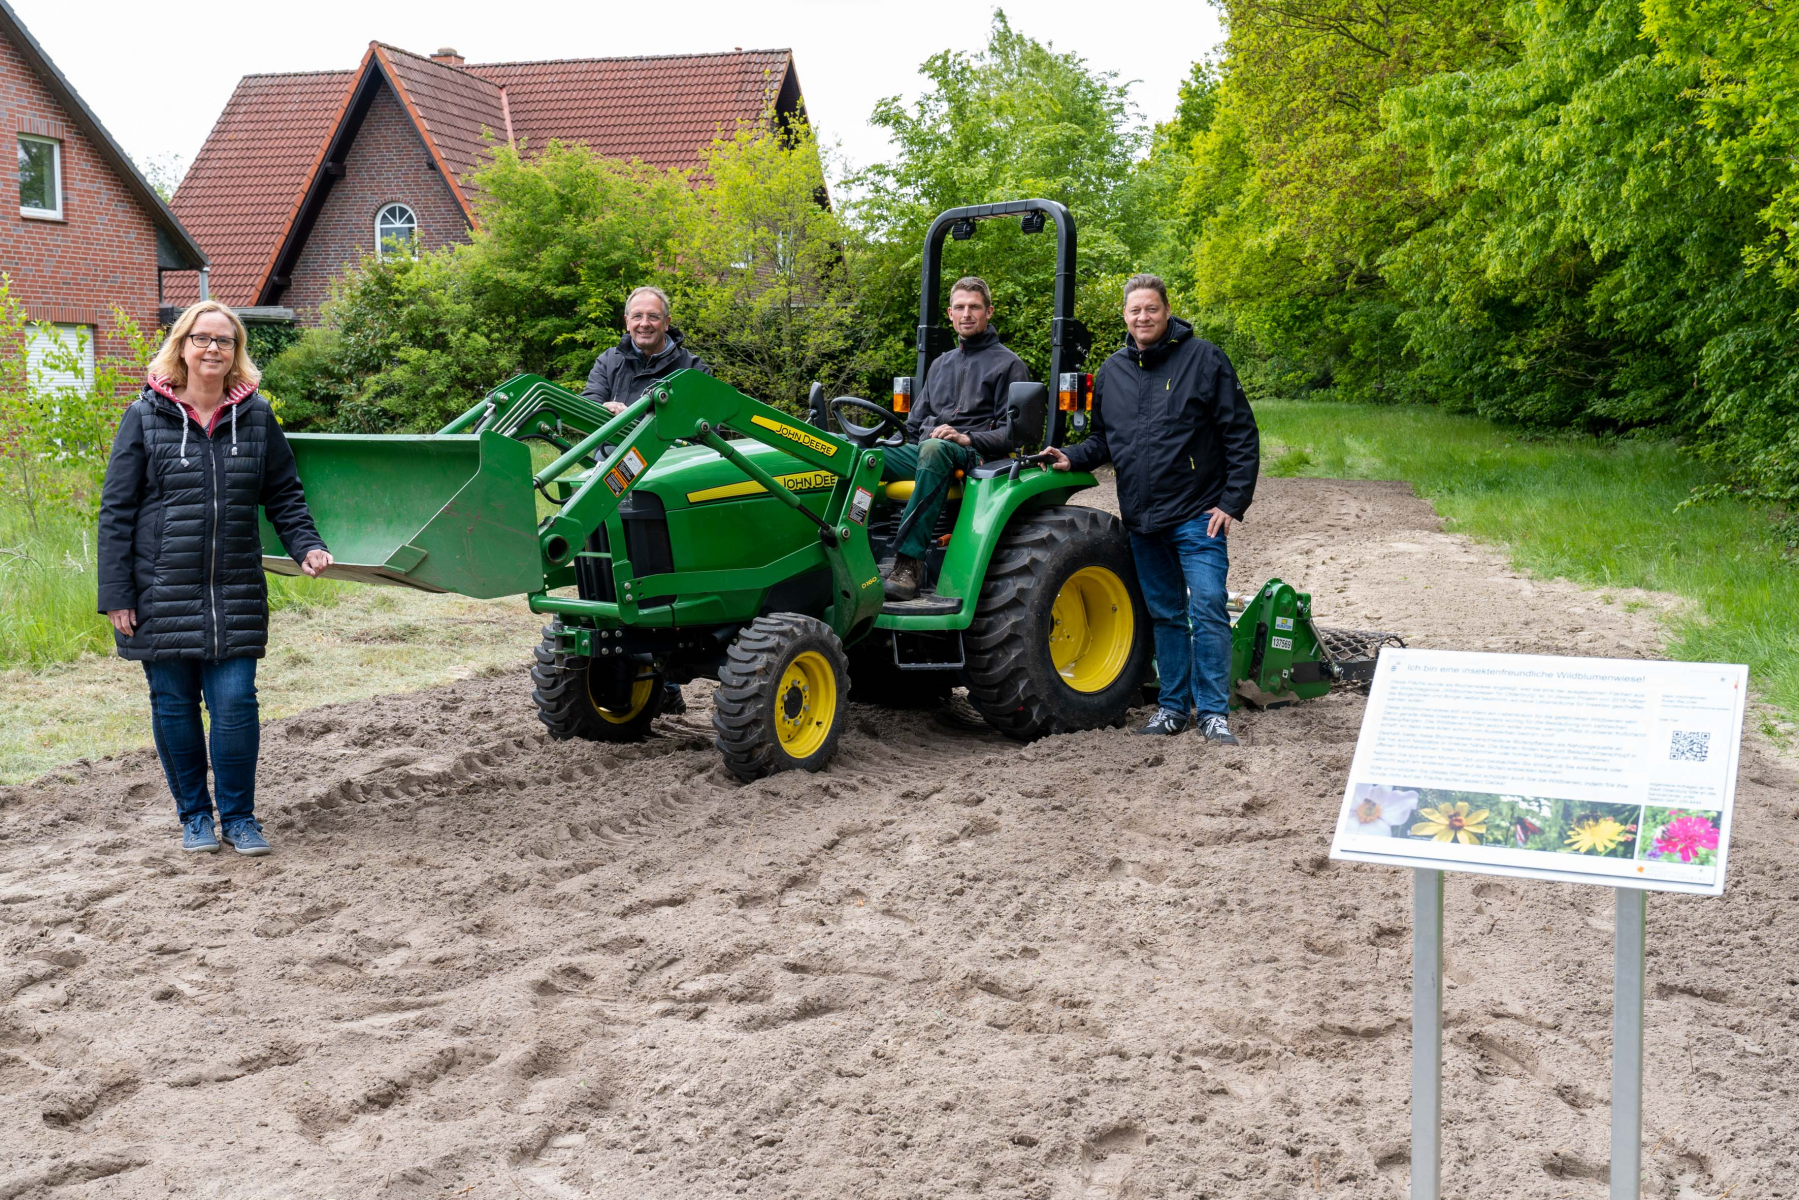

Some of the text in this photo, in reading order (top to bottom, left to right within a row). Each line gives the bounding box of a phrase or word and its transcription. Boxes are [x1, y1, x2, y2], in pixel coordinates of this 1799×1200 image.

[776, 425, 833, 455] JOHN DEERE
[814, 474, 836, 486] DEE
[861, 577, 877, 589] D160
[1273, 638, 1291, 649] 137569
[1407, 664, 1421, 672] Ich
[1423, 665, 1438, 673] bin
[1462, 667, 1554, 679] insektenfreundliche
[1556, 671, 1646, 684] Wildblumenwiese!
